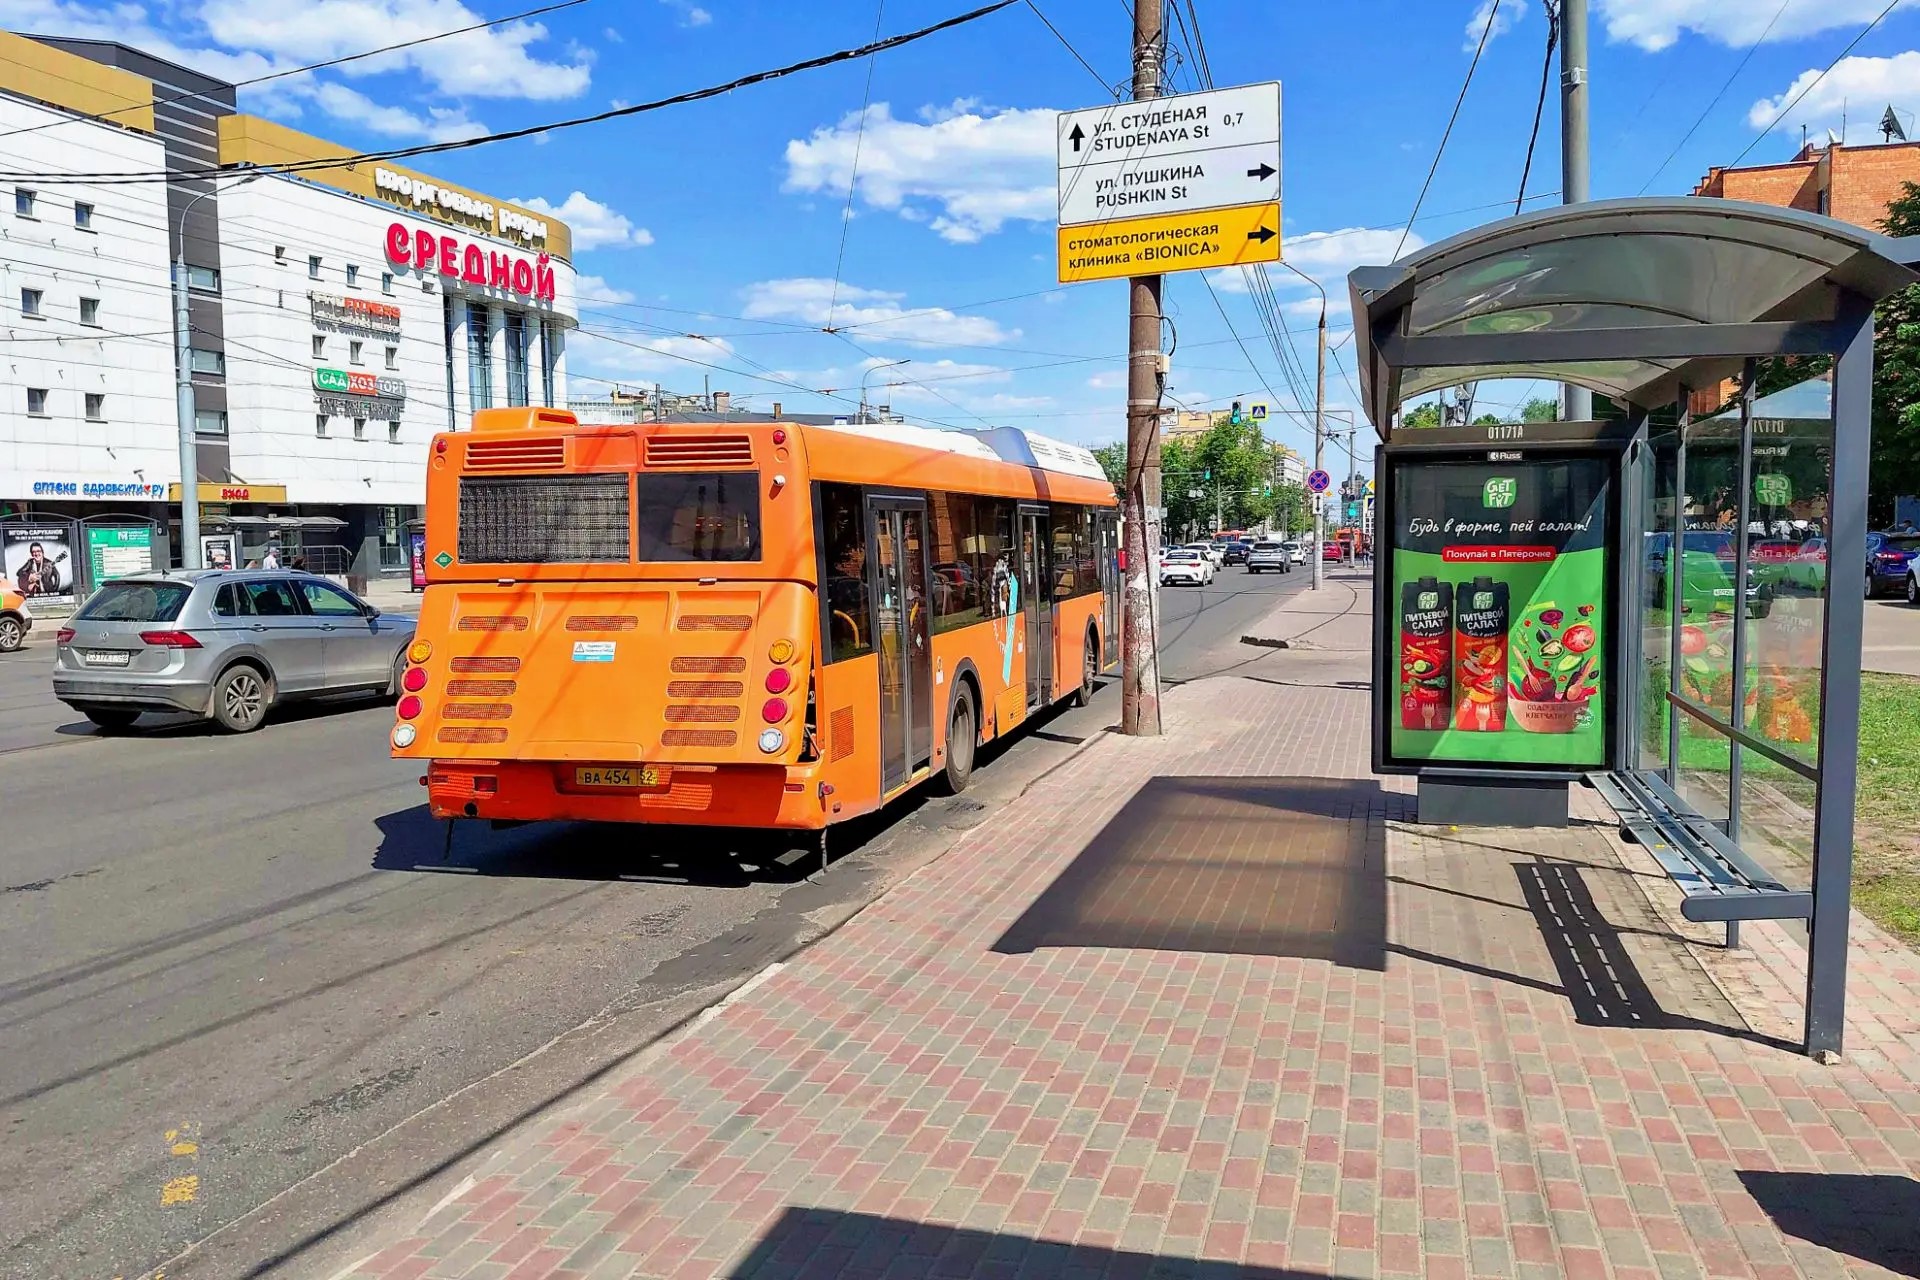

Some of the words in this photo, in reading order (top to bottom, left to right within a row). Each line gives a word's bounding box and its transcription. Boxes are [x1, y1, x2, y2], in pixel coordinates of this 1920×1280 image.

[1094, 121, 1116, 136] ул.
[1121, 106, 1208, 130] СТУДЕНАЯ
[1223, 112, 1244, 127] 0,7
[1094, 128, 1189, 151] STUDENAYA
[1193, 125, 1210, 139] St
[1096, 178, 1118, 193] ул.
[1123, 165, 1205, 187] ПУШКИНА
[374, 167, 495, 222] торговые
[1096, 188, 1166, 208] PUSHKIN
[1171, 185, 1188, 199] St
[1068, 224, 1219, 250] стоматологическая
[386, 222, 555, 302] СРЕДНОЙ
[1069, 253, 1131, 269] клиника
[1136, 241, 1220, 261] «BIONICA»
[1487, 425, 1523, 440] 01171A
[1500, 451, 1521, 460] Russ
[33, 482, 77, 495] аптека
[1486, 478, 1513, 493] GET
[221, 488, 250, 501] ВХОД
[1409, 517, 1440, 537] Будь
[1444, 517, 1455, 533] в
[1455, 521, 1503, 537] форме,
[1510, 519, 1534, 532] пей
[1538, 516, 1592, 532] салат!
[1446, 549, 1489, 561] Покупай
[1491, 551, 1497, 559] в
[1405, 606, 1449, 622] ПИТЬЕВОЙ
[1460, 606, 1504, 622] ПИТЬЕВОЙ
[1412, 619, 1444, 629] САЛАТ
[1467, 619, 1499, 629] САЛАТ
[584, 772, 601, 784] ВА
[604, 770, 630, 785] 454
[639, 770, 654, 782] 52
